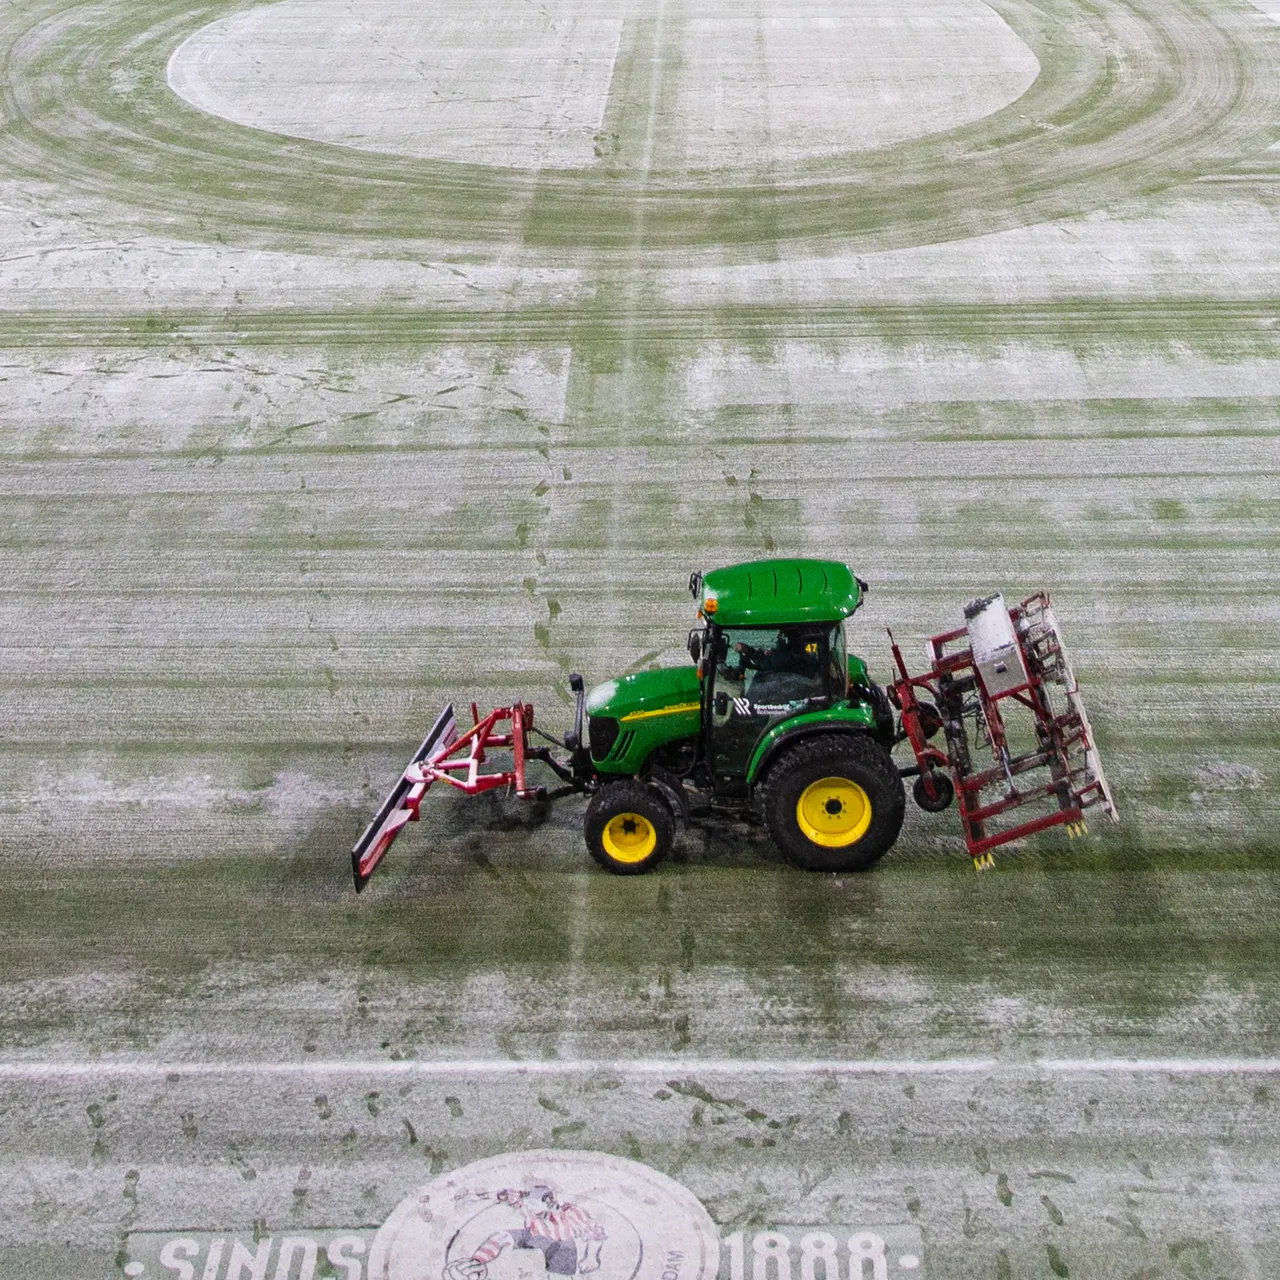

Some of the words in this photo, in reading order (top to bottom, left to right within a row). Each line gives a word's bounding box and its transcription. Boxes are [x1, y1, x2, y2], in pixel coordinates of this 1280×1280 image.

[805, 643, 818, 654] 47
[160, 1236, 368, 1280] SINDS
[723, 1231, 889, 1280] 1888
